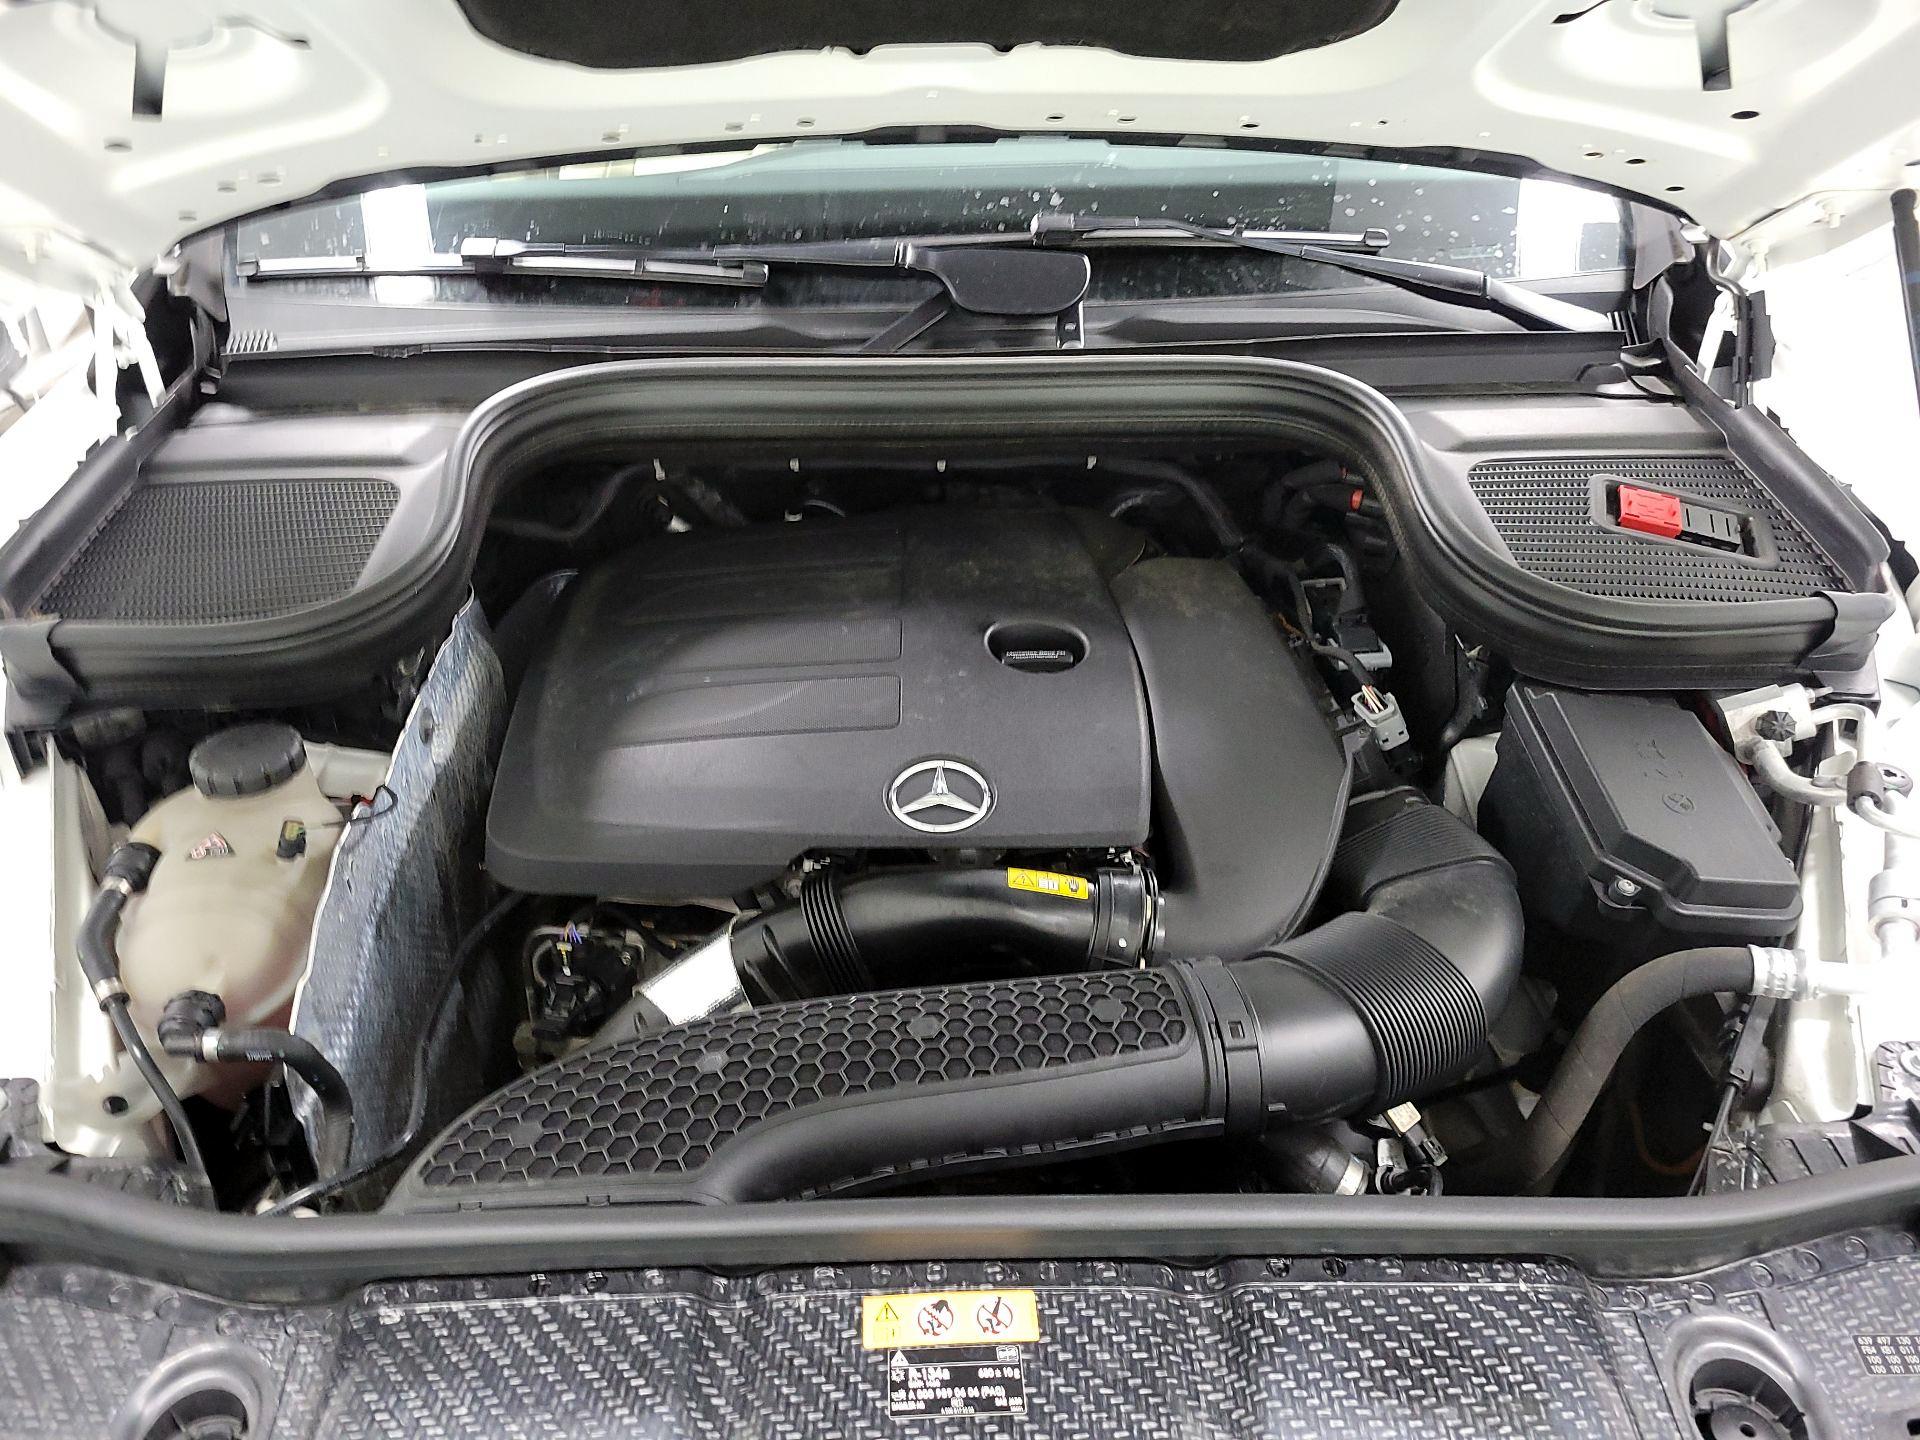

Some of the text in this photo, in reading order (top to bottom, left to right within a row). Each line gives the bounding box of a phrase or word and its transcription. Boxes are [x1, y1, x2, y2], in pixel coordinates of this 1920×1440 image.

[1866, 1355, 1919, 1364] 100 100 100
[1870, 1365, 1887, 1374] 100
[1889, 1365, 1905, 1374] 101
